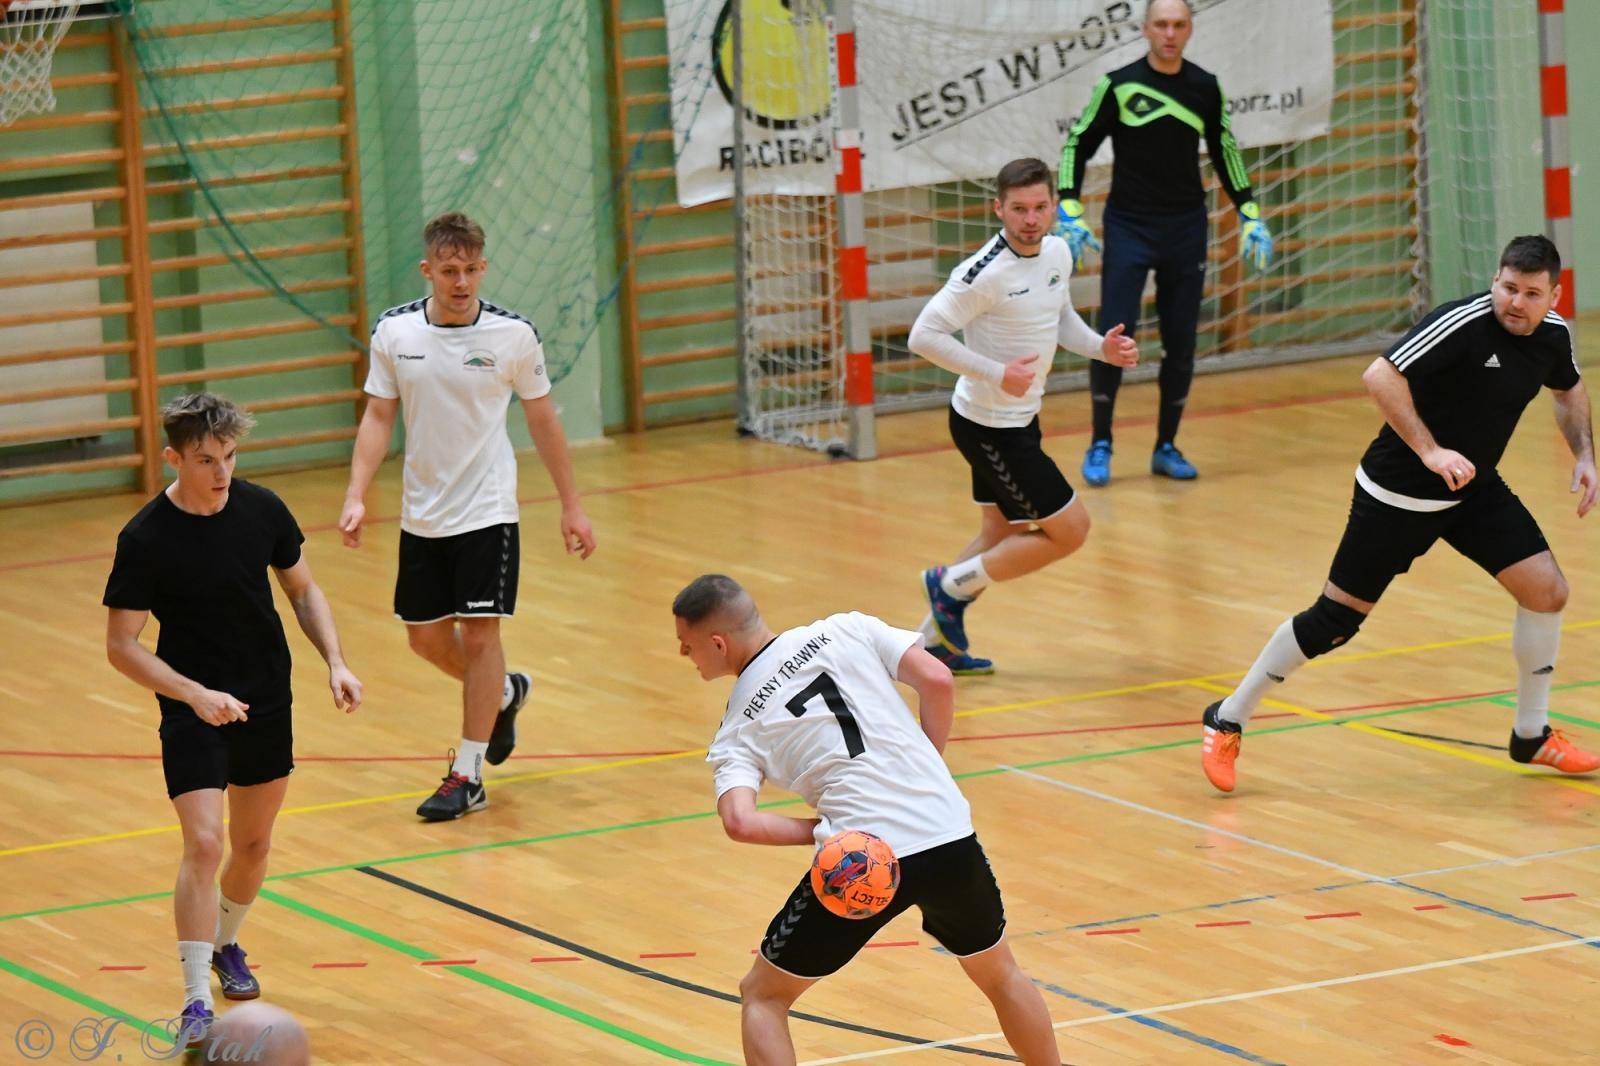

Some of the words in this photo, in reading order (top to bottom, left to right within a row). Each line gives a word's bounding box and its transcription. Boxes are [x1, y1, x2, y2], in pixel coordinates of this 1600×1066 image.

[891, 66, 986, 141] JEST
[998, 46, 1041, 89] W
[743, 676, 782, 721] PIĘKNY
[778, 633, 832, 680] TRAWNIK
[785, 671, 866, 759] 7
